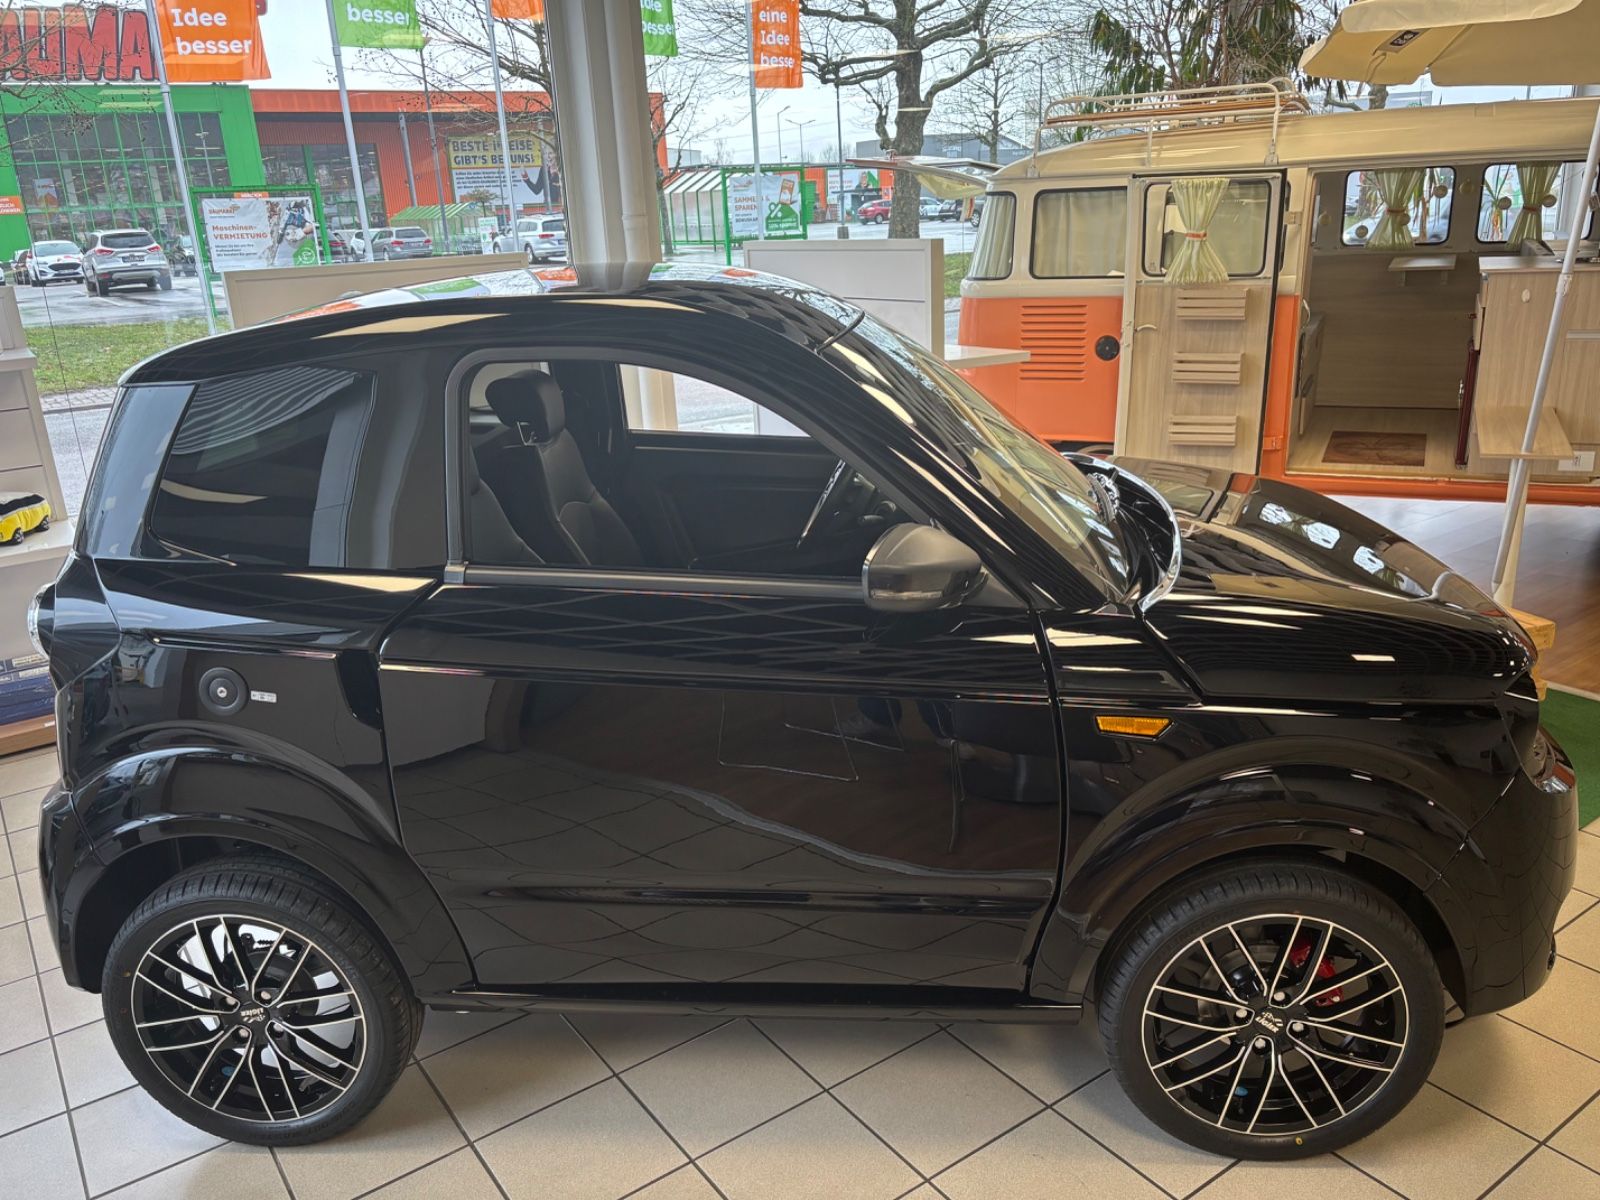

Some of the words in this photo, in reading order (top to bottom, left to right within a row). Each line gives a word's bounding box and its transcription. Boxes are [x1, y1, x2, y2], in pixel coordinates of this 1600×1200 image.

[170, 7, 227, 27] Idee
[759, 6, 788, 23] eine
[0, 4, 162, 81] AUMA
[175, 36, 252, 55] besser
[760, 29, 790, 46] Idee
[760, 52, 795, 68] besse
[452, 140, 488, 152] BESTE
[453, 155, 488, 165] GIBT'S
[491, 154, 504, 165] BE
[510, 153, 534, 164] UNS!
[213, 232, 268, 240] VERMIETUNG
